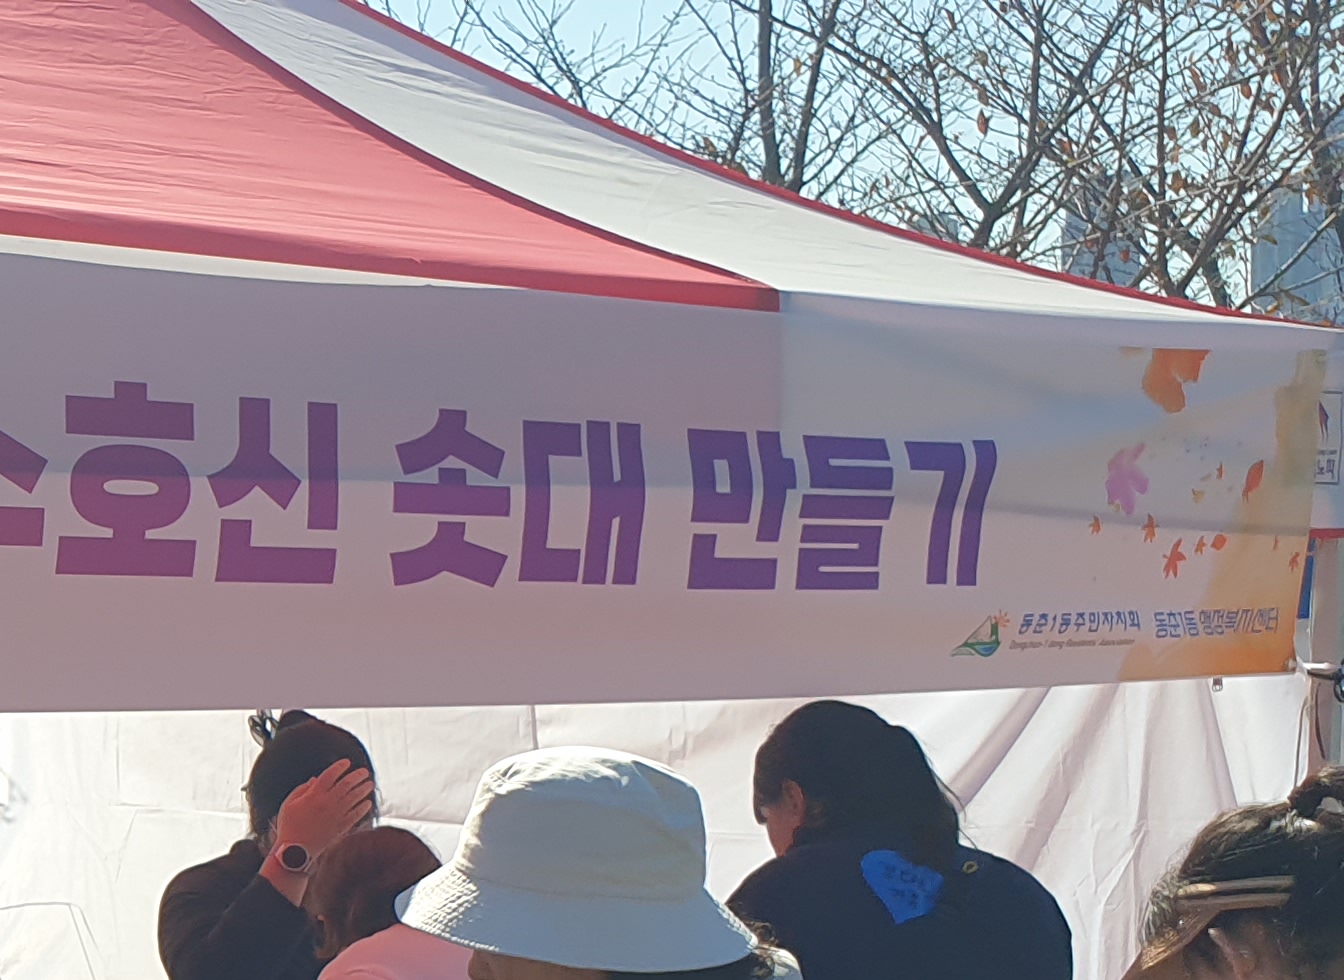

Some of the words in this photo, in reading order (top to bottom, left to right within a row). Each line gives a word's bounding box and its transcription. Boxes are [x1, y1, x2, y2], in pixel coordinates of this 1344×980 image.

[389, 408, 647, 588] 솟대
[686, 426, 998, 590] 만들기
[1018, 610, 1141, 635] 동춘1동주민자치회
